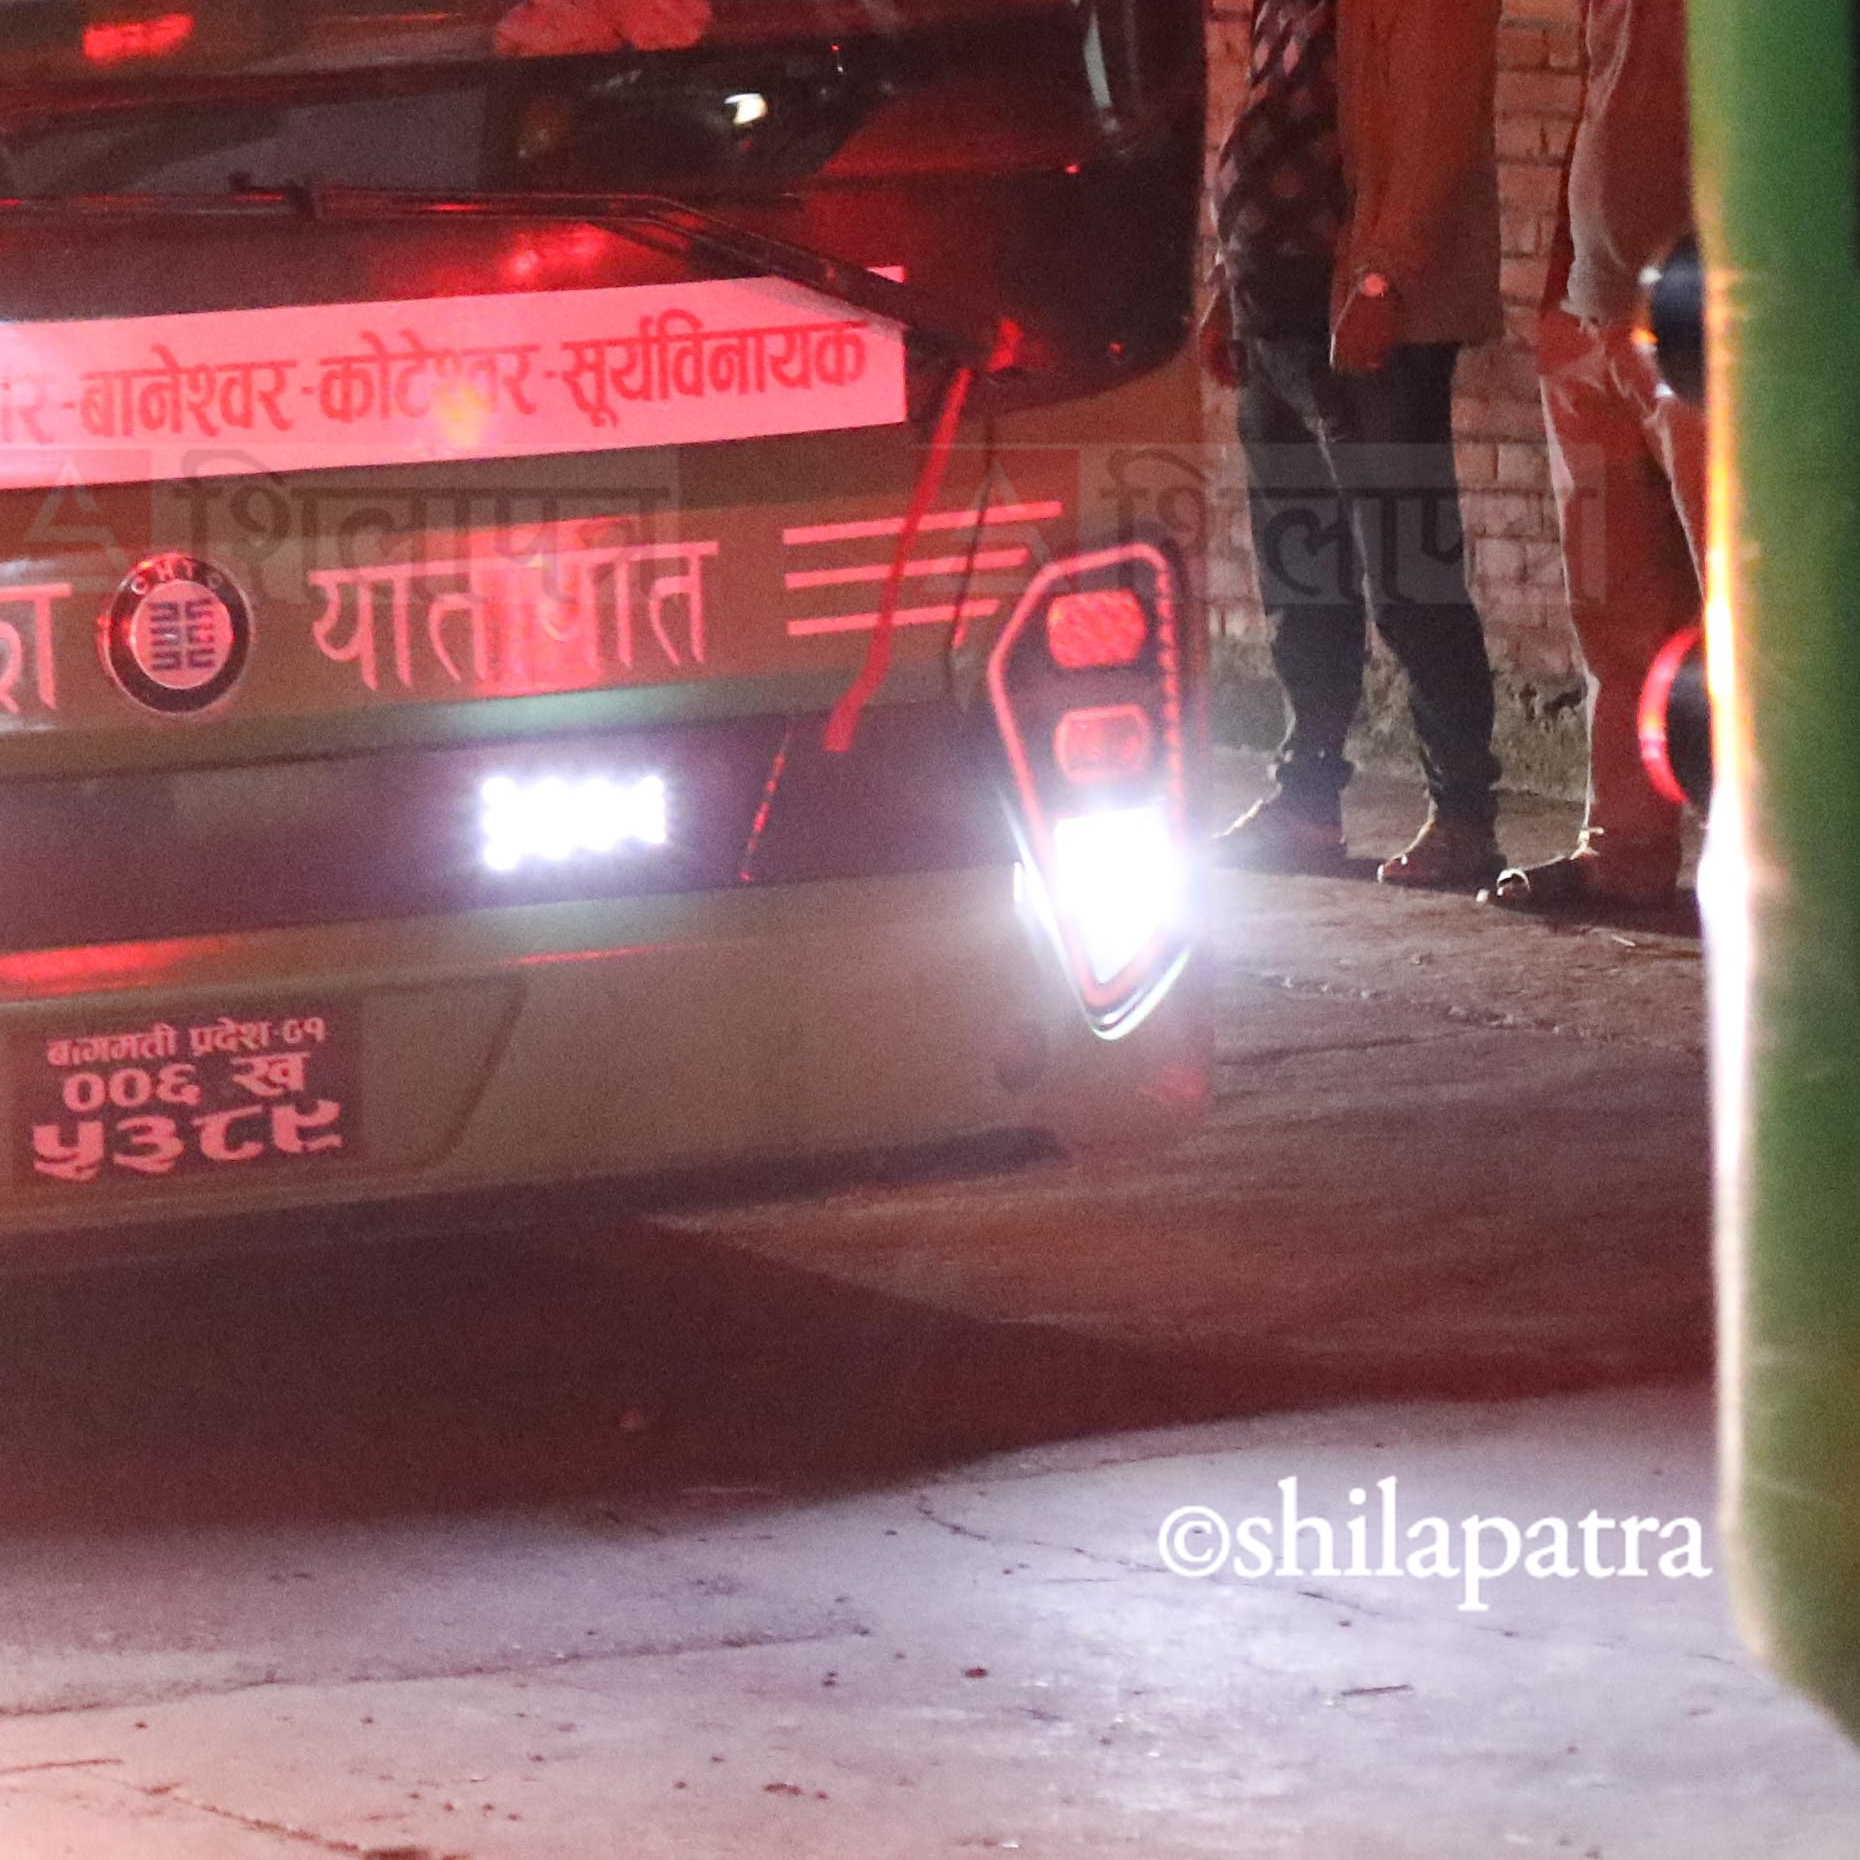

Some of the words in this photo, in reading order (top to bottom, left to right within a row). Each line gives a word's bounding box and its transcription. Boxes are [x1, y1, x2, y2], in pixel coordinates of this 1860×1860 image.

[308, 540, 718, 690] यातायात
[62, 1063, 201, 1112] ००६
[231, 1051, 310, 1097] ख
[31, 1099, 343, 1182] ५३८९
